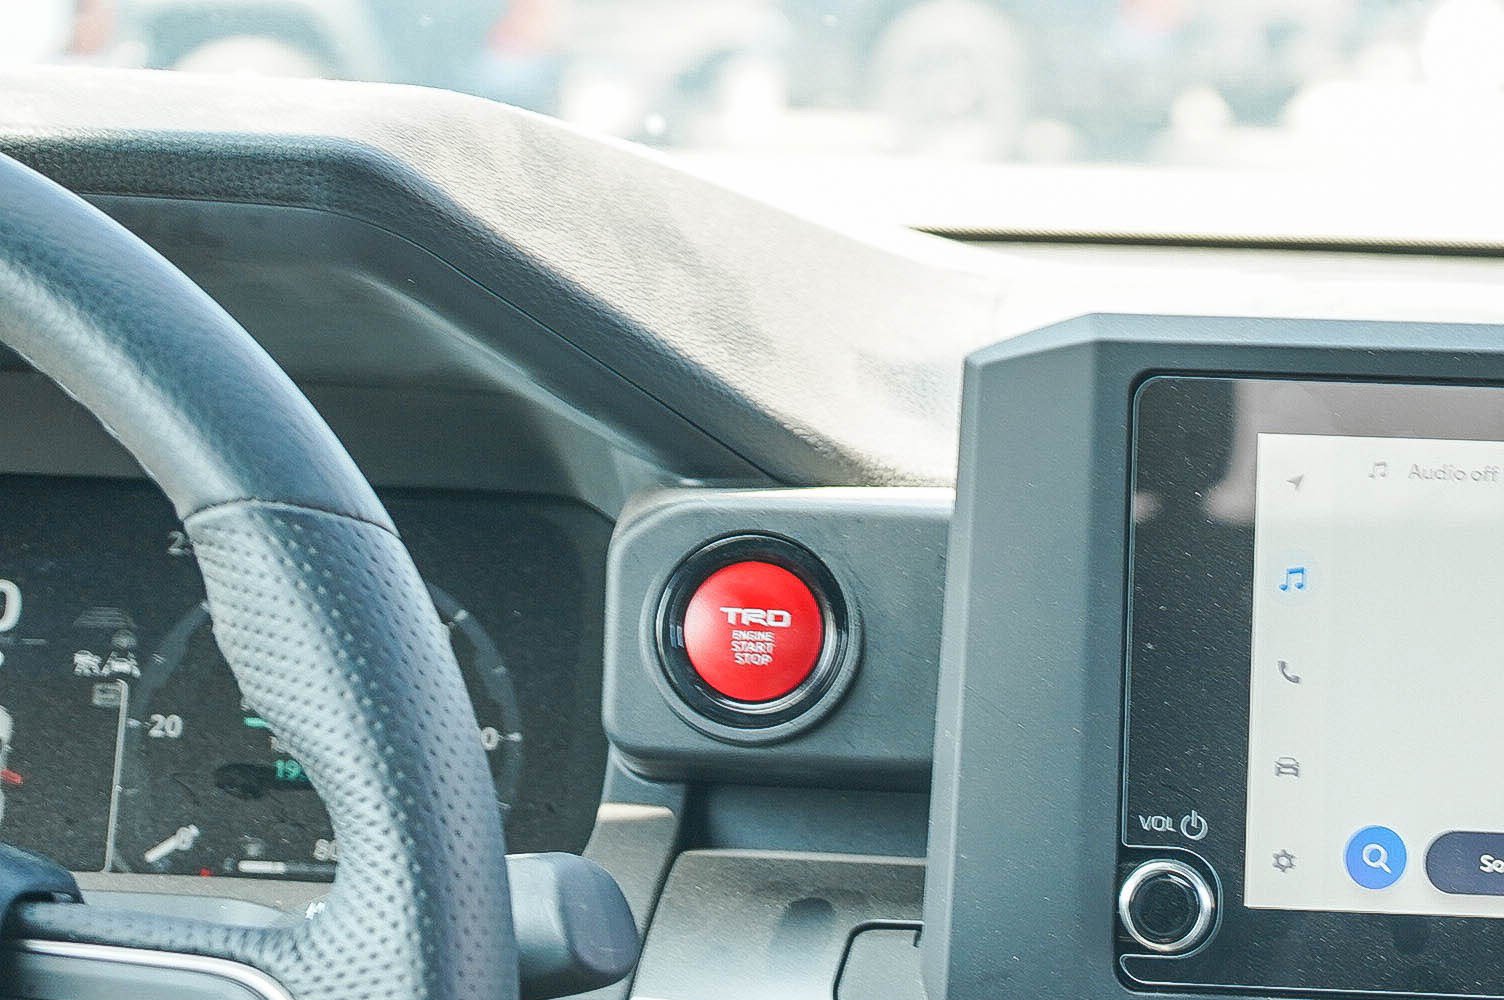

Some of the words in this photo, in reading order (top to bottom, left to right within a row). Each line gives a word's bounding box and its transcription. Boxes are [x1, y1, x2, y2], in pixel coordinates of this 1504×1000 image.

[1408, 463, 1466, 482] Audio
[1469, 464, 1500, 482] off
[719, 606, 792, 628] TRD
[731, 629, 776, 643] ENGINE
[730, 640, 776, 654] START
[734, 652, 773, 667] STOP
[150, 713, 184, 738] 20
[1138, 814, 1178, 833] VOL
